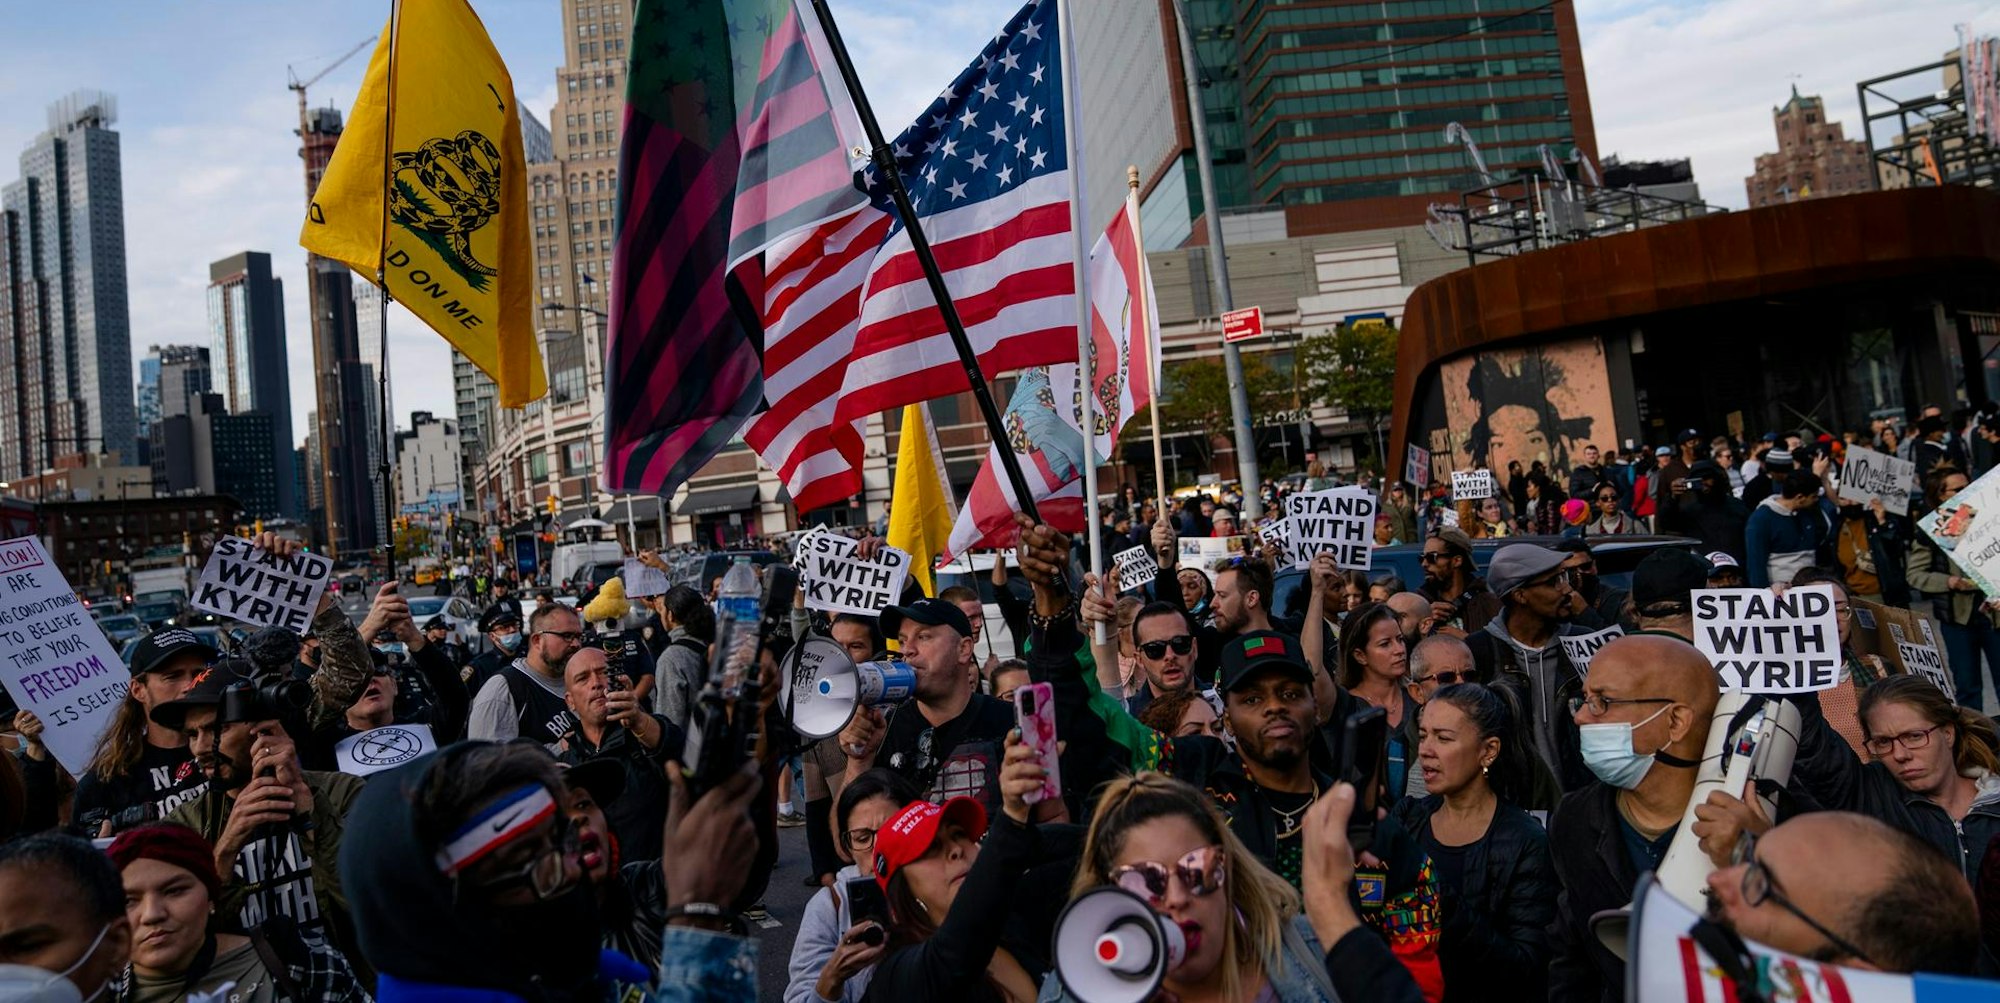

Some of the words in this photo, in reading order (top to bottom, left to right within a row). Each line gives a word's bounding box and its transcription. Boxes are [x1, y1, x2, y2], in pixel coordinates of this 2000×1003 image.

[409, 270, 448, 299] ON
[442, 300, 483, 330] ME
[1453, 472, 1488, 480] STAND
[1456, 480, 1487, 489] WITH
[1843, 458, 1869, 489] NO
[1293, 496, 1373, 517] STAND
[1455, 488, 1489, 498] KYRIE
[1297, 518, 1365, 541] WITH
[1115, 548, 1145, 562] STAND
[1120, 558, 1151, 576] WITH
[7, 572, 42, 593] ARE
[219, 558, 313, 606] WITH
[818, 556, 892, 589] WITH
[1121, 566, 1158, 588] KYRIE
[12, 592, 79, 623] CONDITIONED
[199, 582, 309, 633] KYRIE
[808, 579, 890, 611] KYRIE
[1696, 592, 1830, 620] STAND
[0, 631, 24, 647] TO
[29, 612, 82, 640] BELIEVE
[1706, 624, 1825, 655] WITH
[8, 647, 43, 670] THAT
[46, 633, 90, 659] YOUR
[1900, 644, 1941, 669] STAND
[19, 654, 109, 704] FREEDOM
[49, 705, 79, 727] IS
[78, 680, 129, 714] SELFISH
[902, 815, 923, 835] KILL
[240, 876, 319, 929] WTH
